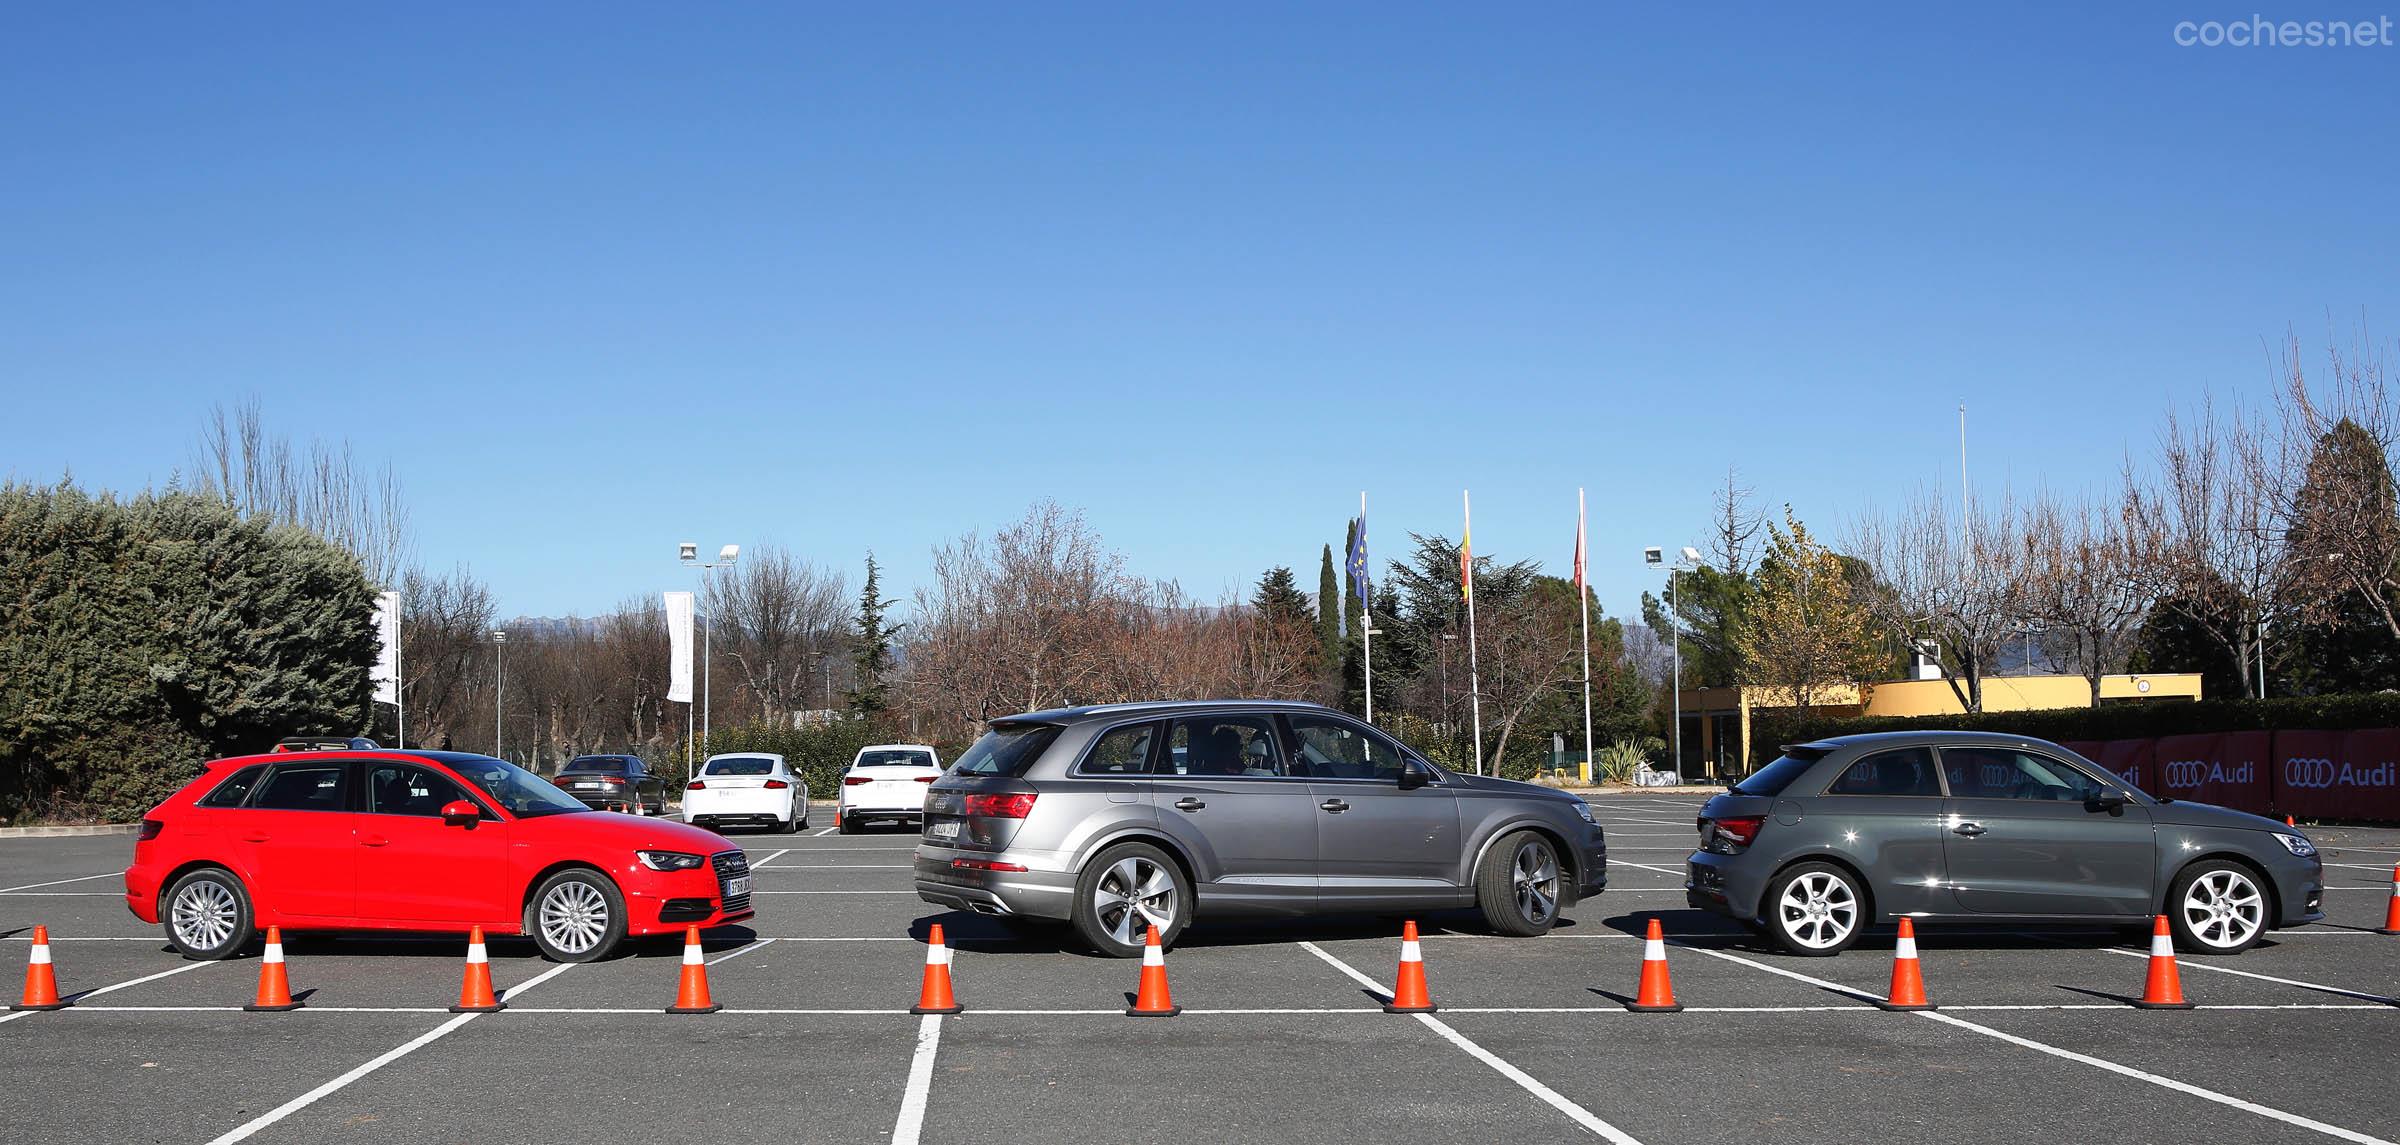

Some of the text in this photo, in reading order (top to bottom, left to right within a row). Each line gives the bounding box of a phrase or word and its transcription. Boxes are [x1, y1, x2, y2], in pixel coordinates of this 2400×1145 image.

[2114, 766, 2140, 786] di
[2209, 761, 2255, 785] Audi
[2338, 763, 2395, 786] Audi
